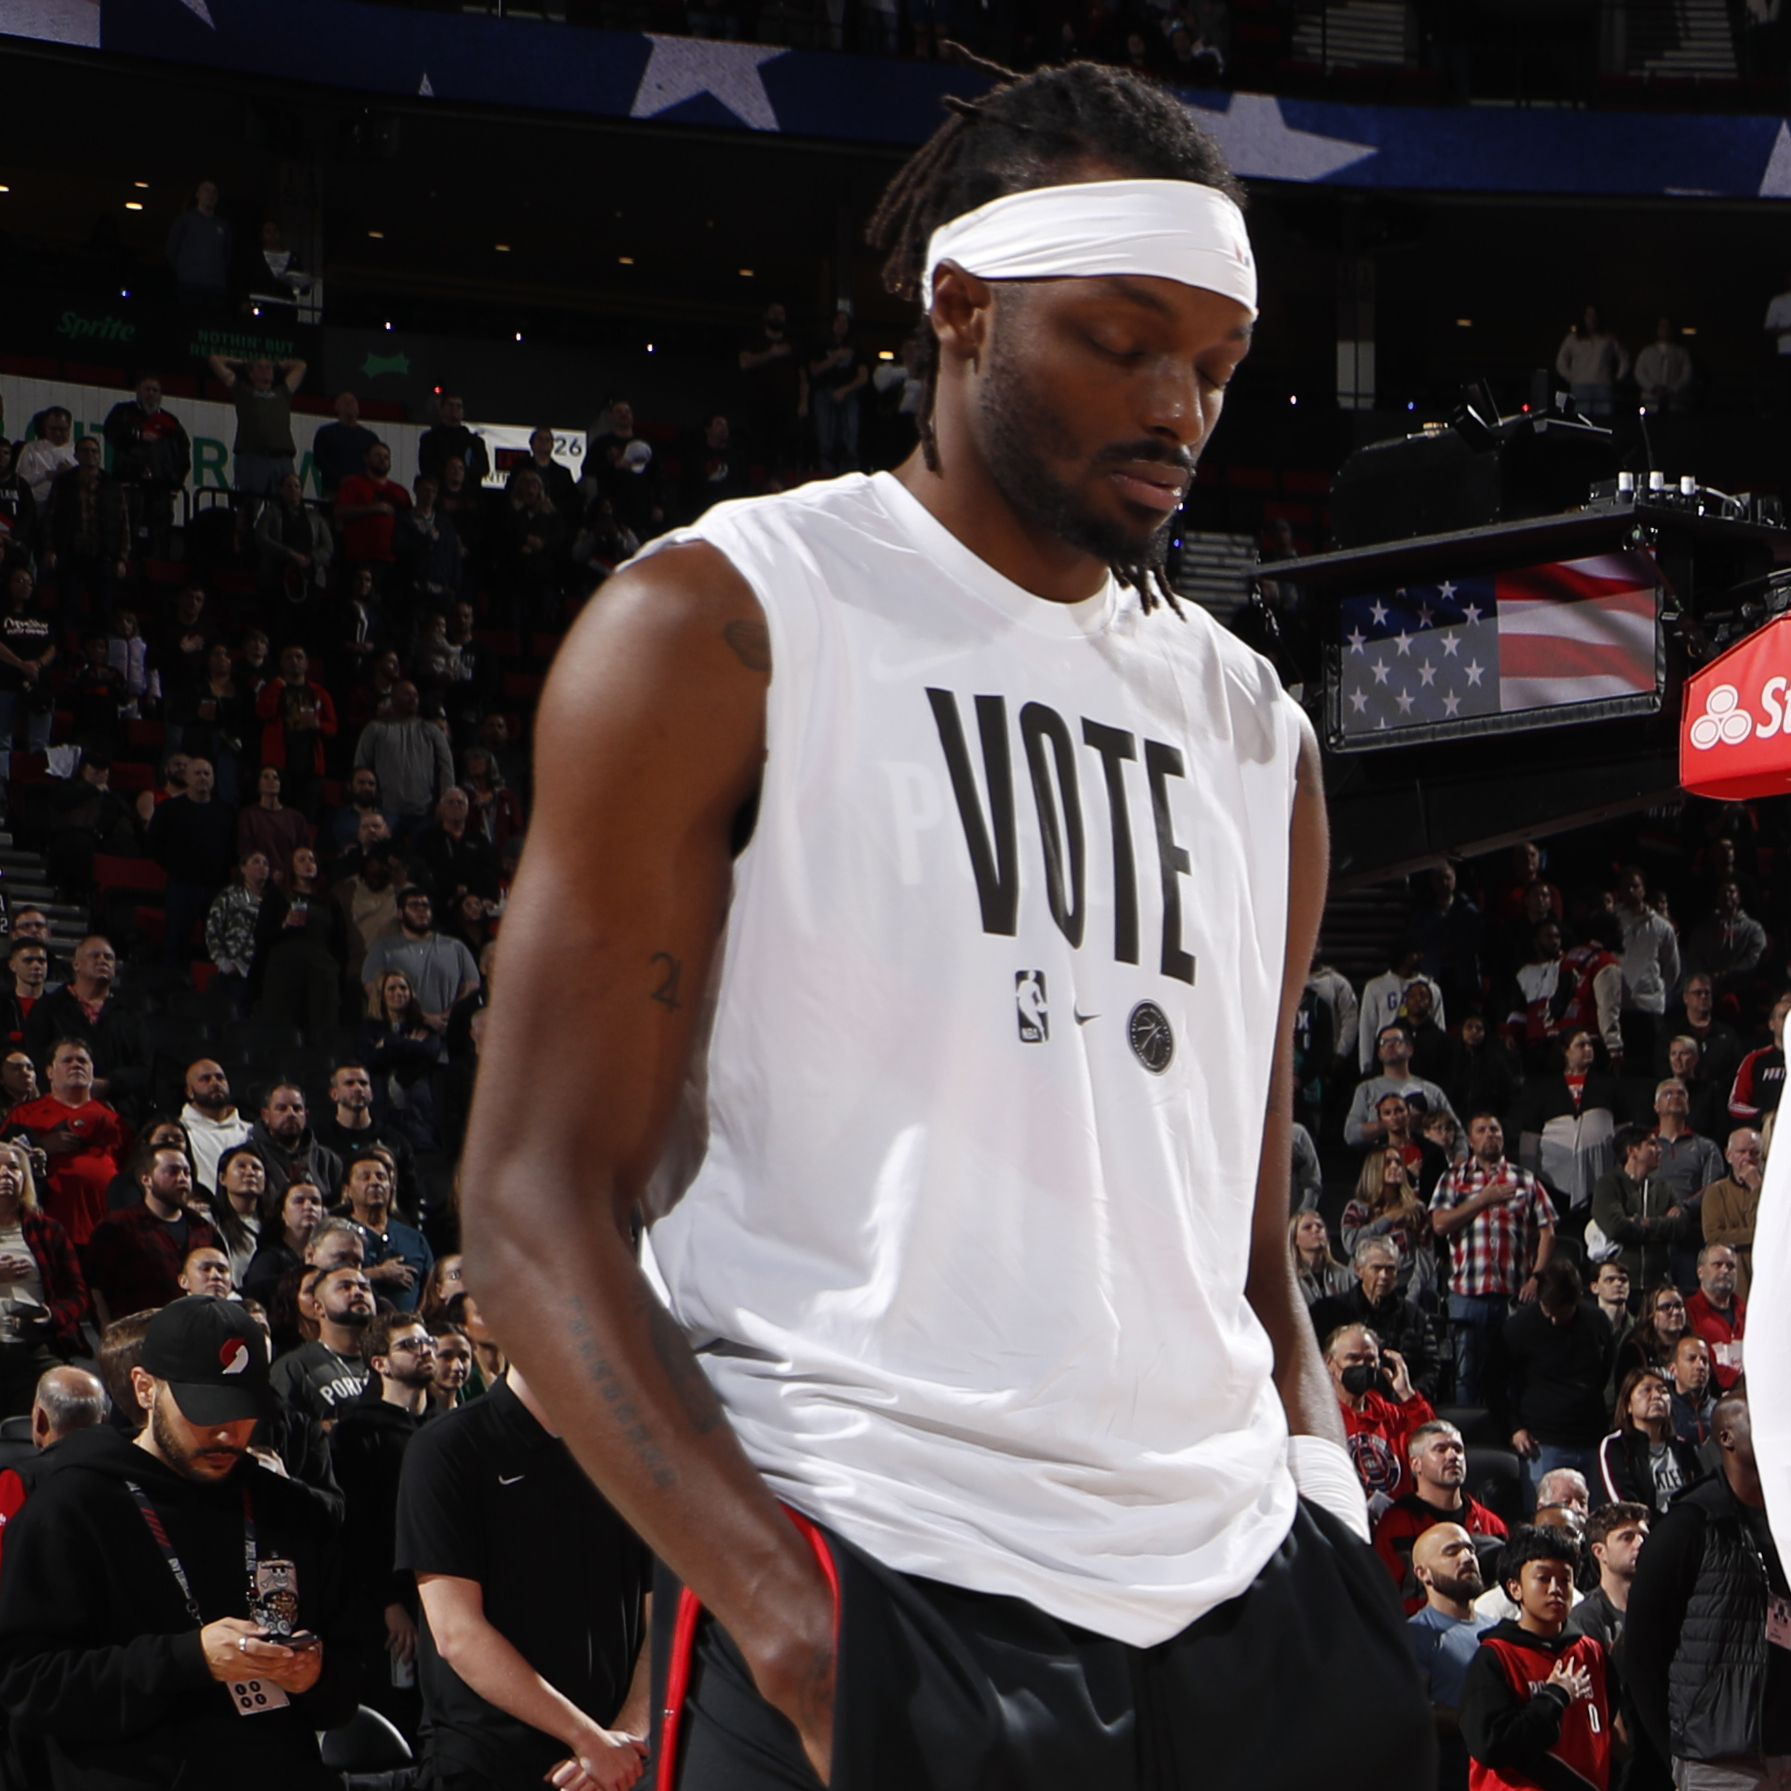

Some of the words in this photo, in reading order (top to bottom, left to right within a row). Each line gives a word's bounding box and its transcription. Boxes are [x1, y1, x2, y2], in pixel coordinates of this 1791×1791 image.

[56, 311, 137, 342] Sprite
[265, 337, 295, 353] BUT
[924, 686, 1196, 987] VOTE
[1587, 1702, 1601, 1734] 0
